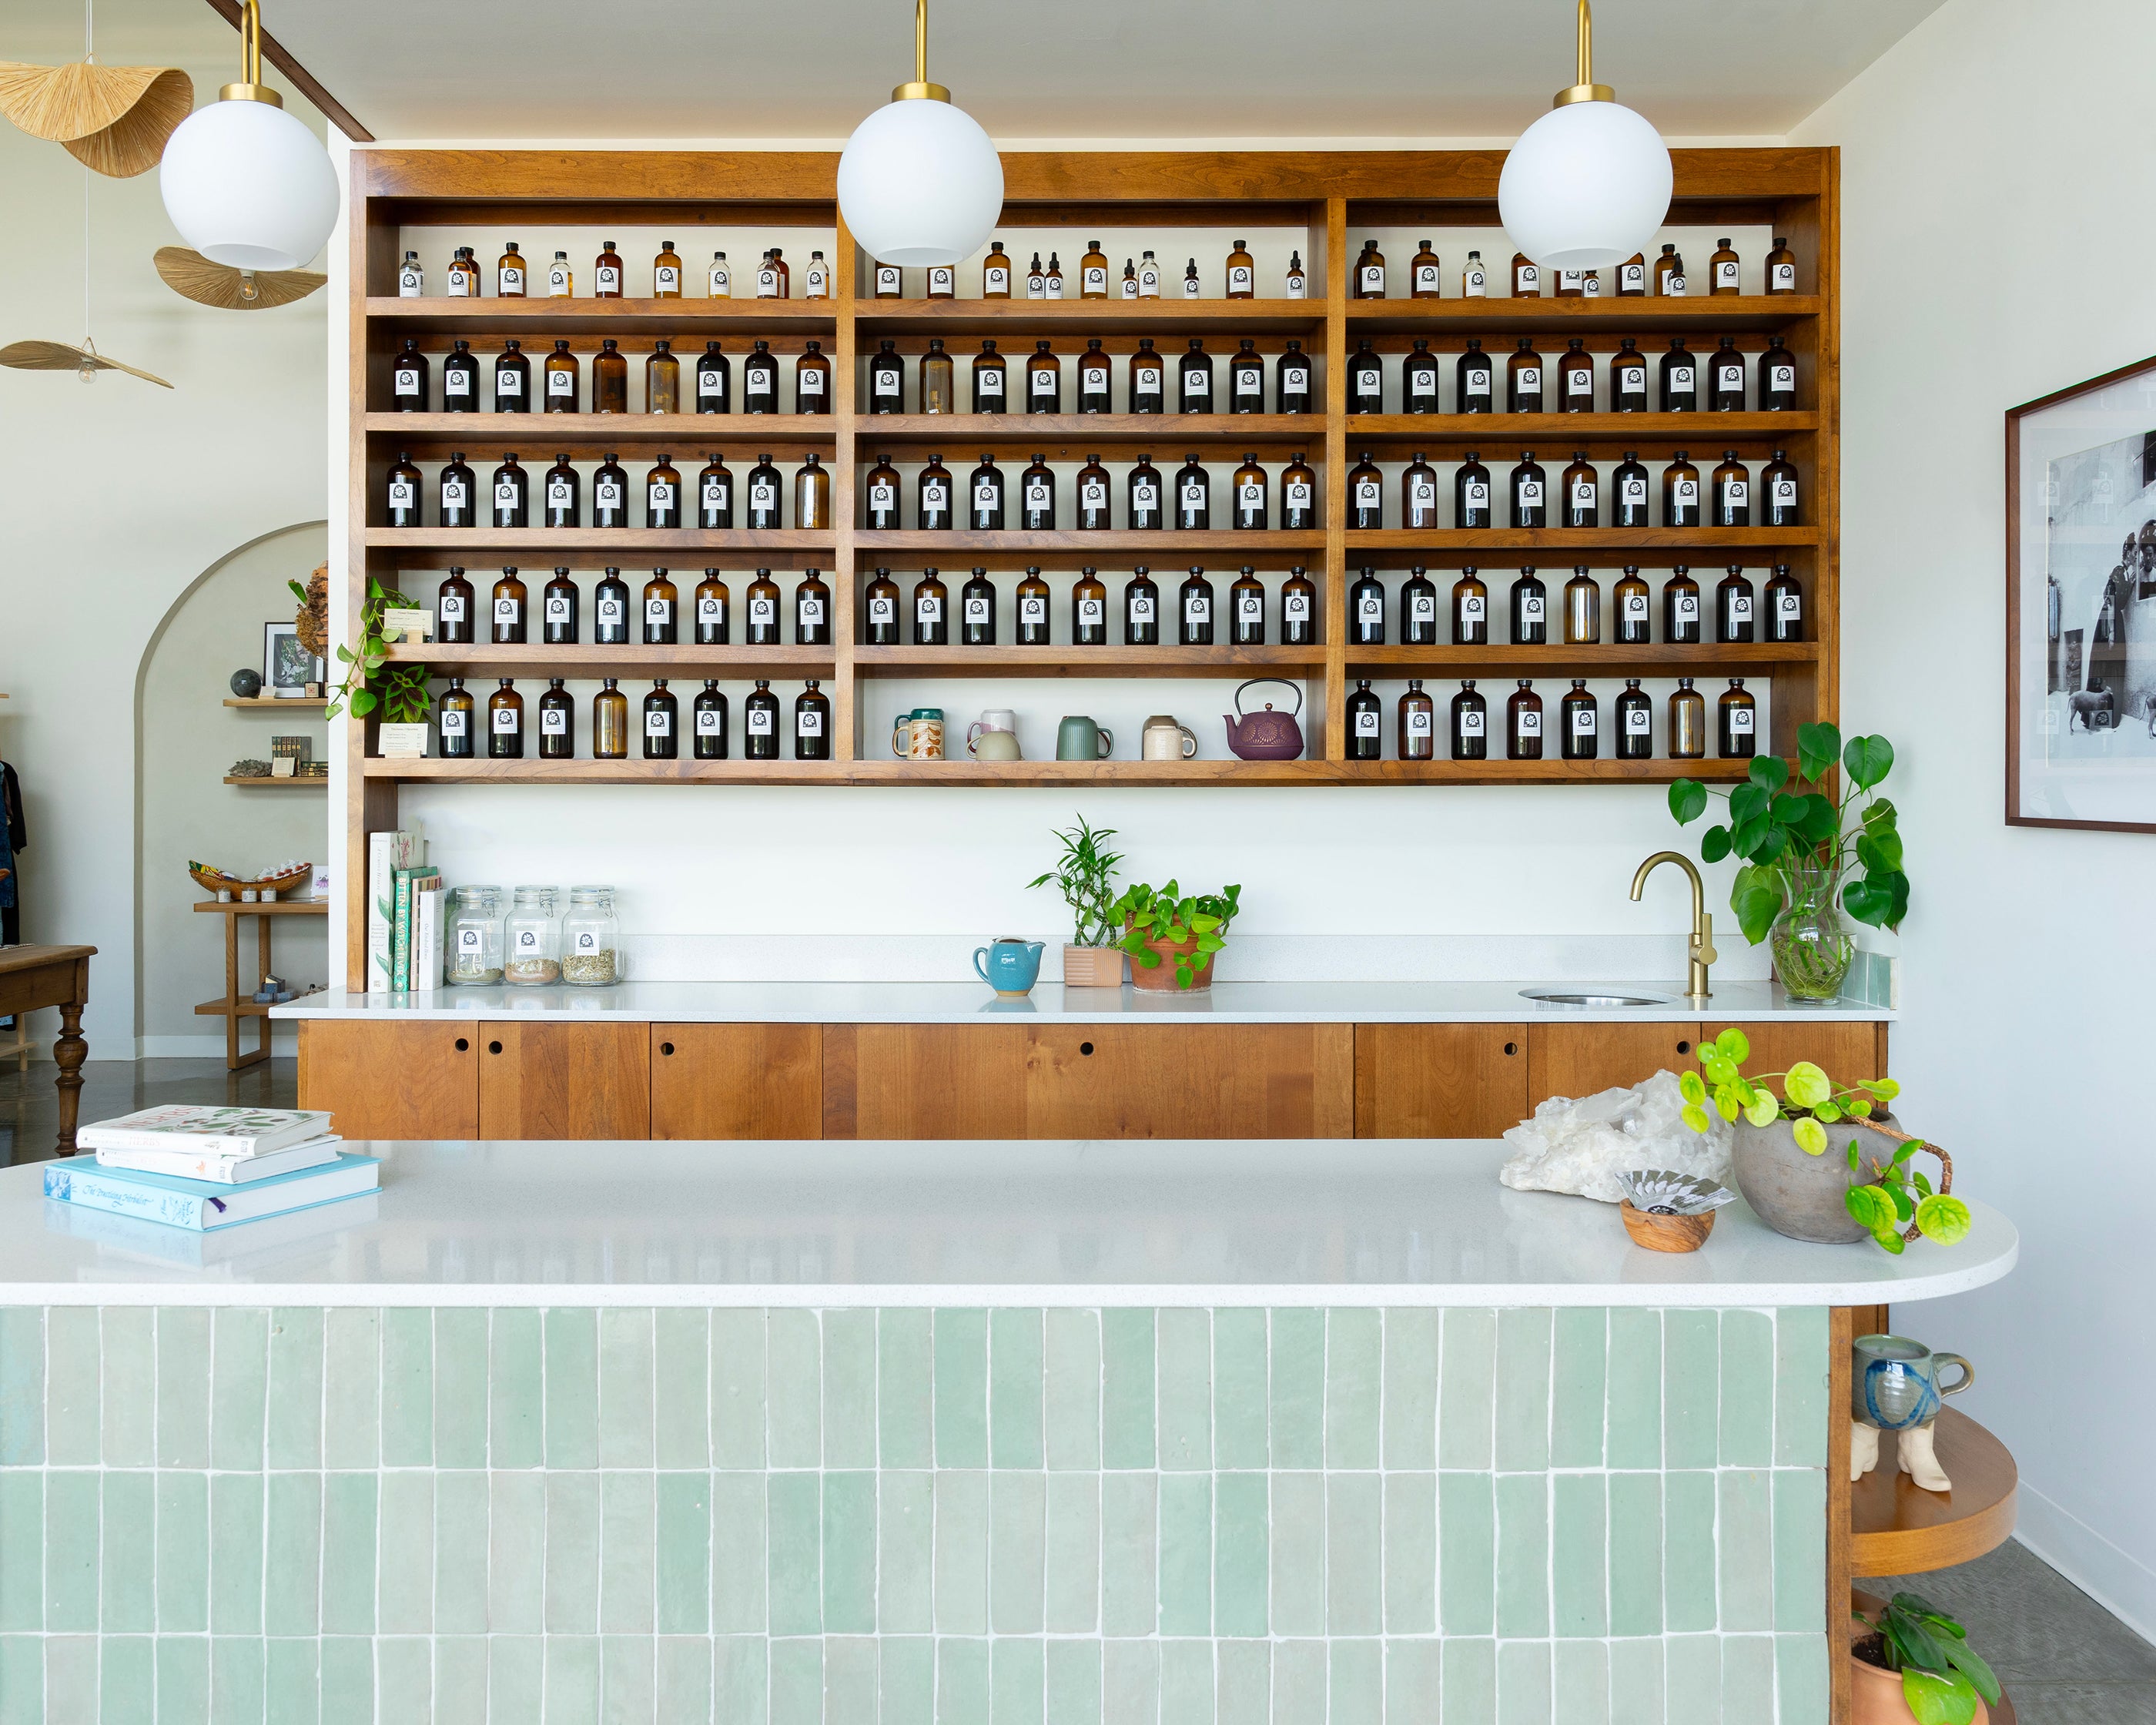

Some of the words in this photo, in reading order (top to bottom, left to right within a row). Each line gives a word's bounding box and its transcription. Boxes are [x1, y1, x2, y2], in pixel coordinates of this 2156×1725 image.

[397, 878, 407, 906] BITTEN
[397, 909, 407, 919] BY
[397, 919, 407, 950] WITCH
[396, 952, 406, 976] FEVER
[110, 1107, 203, 1129] HERBS
[129, 1136, 161, 1147] HERBS
[82, 1184, 97, 1195] The
